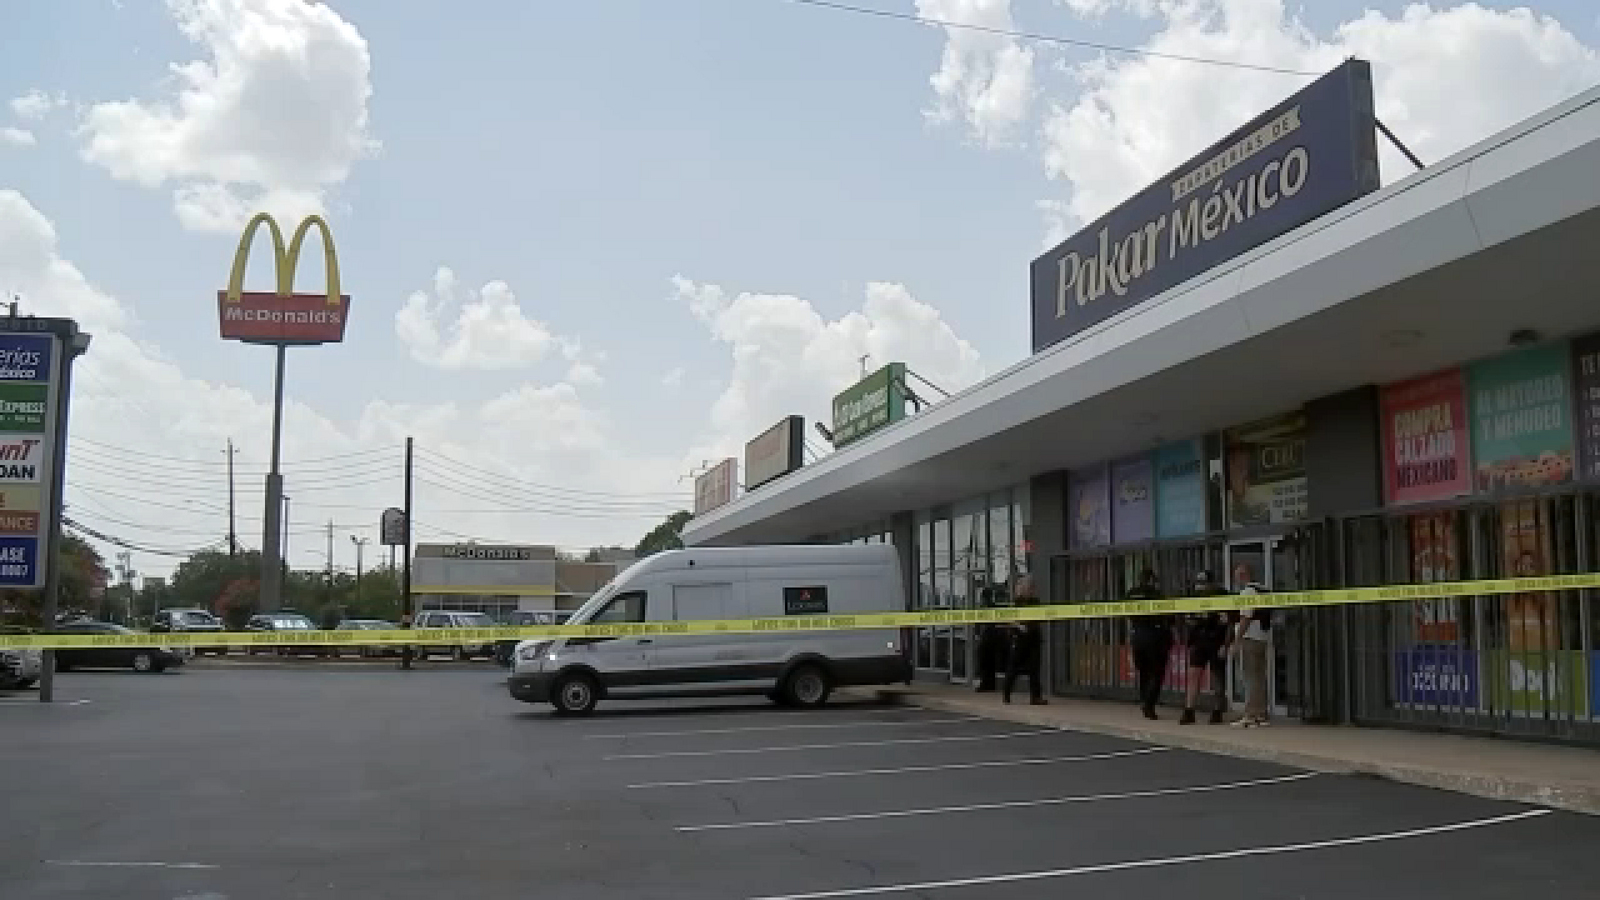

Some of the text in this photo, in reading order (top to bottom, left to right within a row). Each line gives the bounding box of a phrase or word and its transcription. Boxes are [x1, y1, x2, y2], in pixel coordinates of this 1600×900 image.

[1271, 117, 1289, 138] DE
[1055, 215, 1166, 320] Pakar
[1494, 402, 1561, 440] MENUDEO
